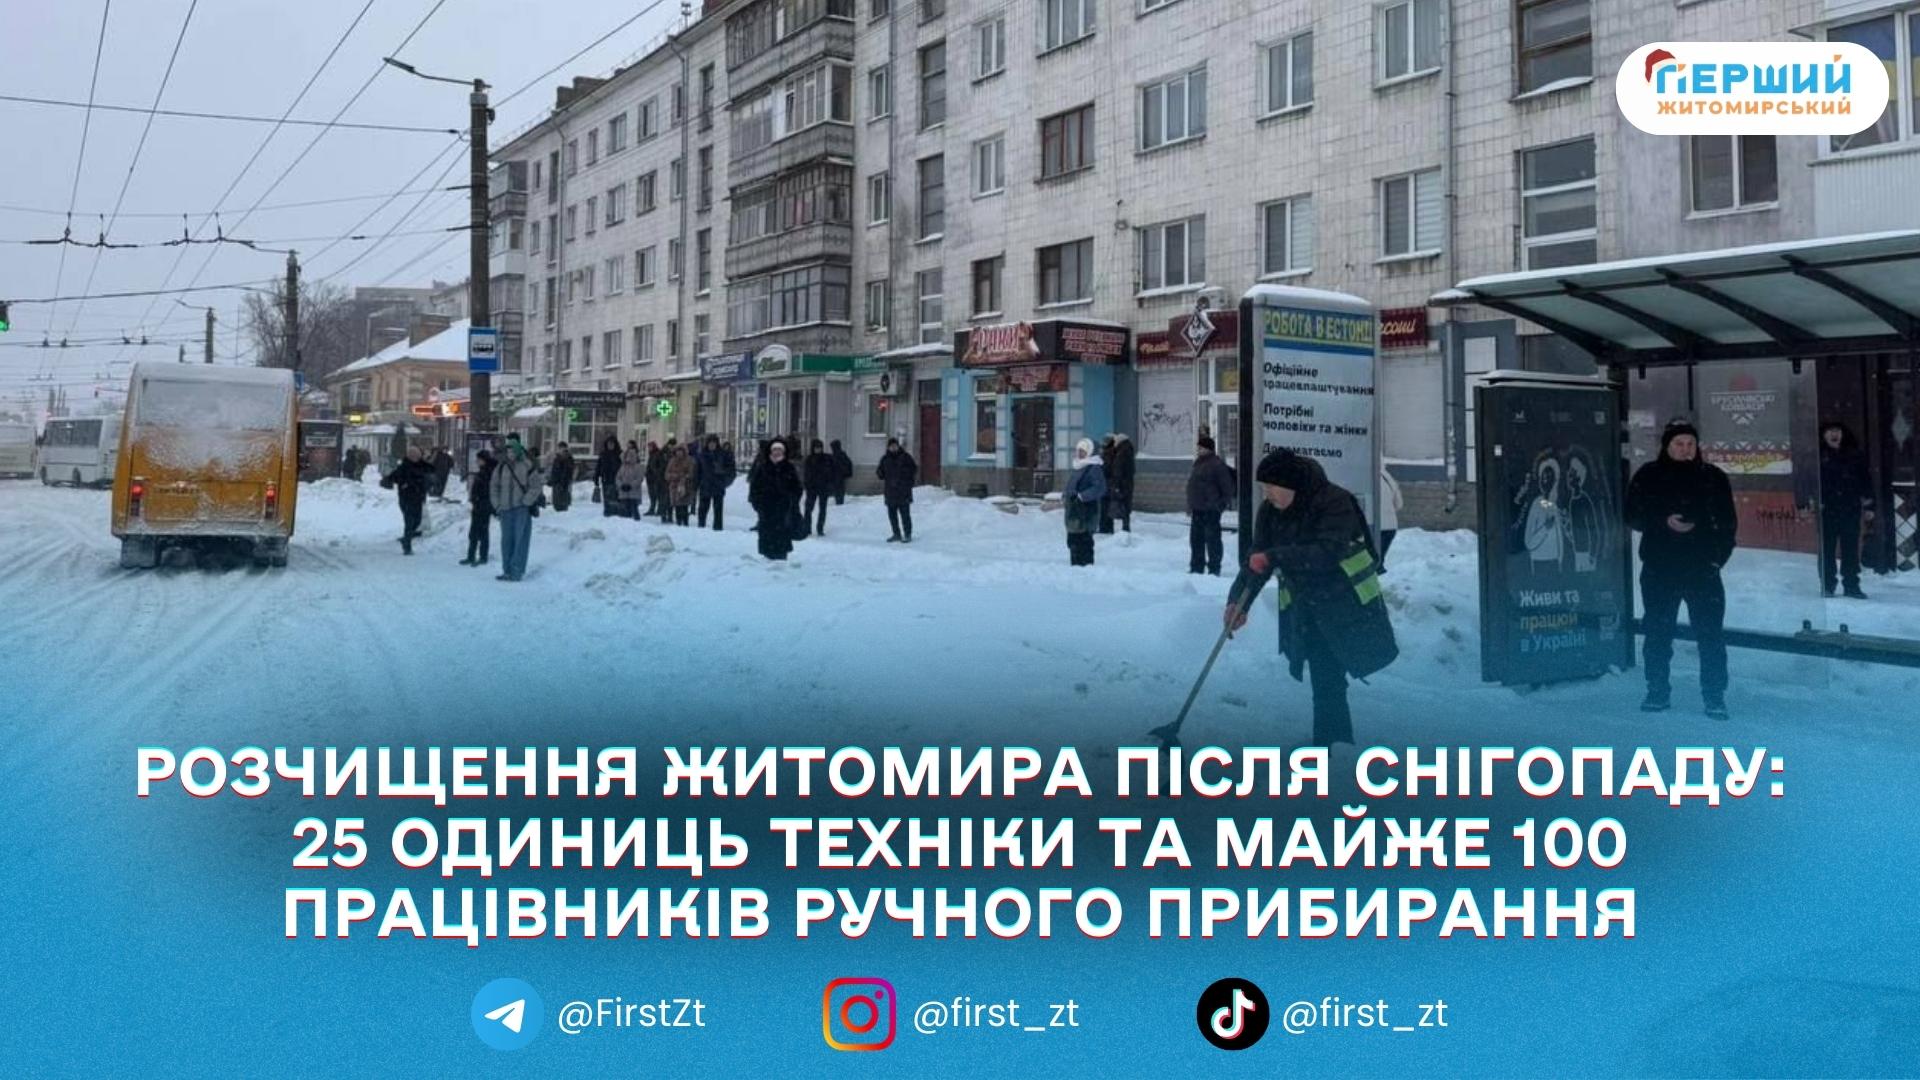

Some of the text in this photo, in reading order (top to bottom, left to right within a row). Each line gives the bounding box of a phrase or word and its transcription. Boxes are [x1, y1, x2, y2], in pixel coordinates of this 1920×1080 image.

[1264, 310, 1312, 336] РОБОТА
[1316, 315, 1324, 338] В
[1263, 361, 1319, 377] Офіційно
[1264, 402, 1314, 418] Потрібні
[1319, 423, 1332, 434] та
[1334, 423, 1368, 436] жінки
[1520, 589, 1580, 608] Живи та
[1520, 629, 1586, 654] в Україні
